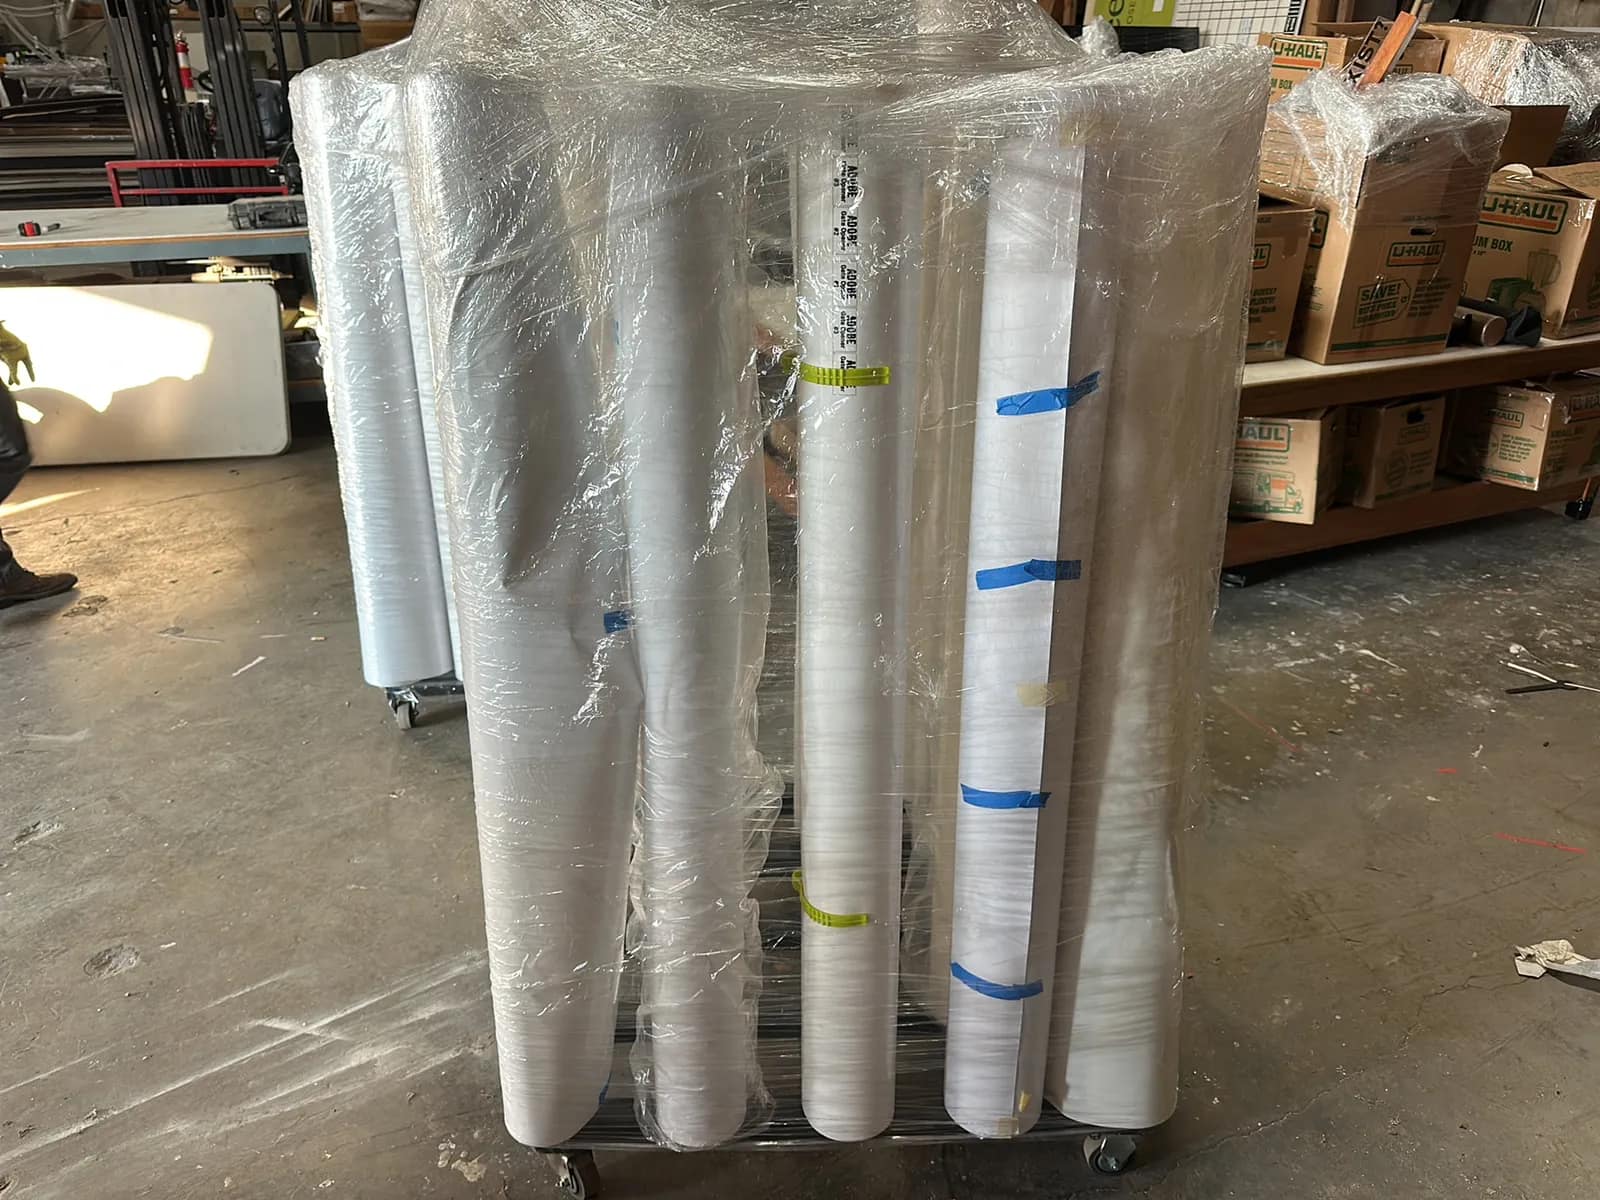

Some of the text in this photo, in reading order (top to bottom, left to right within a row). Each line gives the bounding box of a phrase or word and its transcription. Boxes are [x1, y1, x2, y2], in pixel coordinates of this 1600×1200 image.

[1273, 41, 1323, 60] U-HAUL
[847, 165, 858, 199] ADOBE
[1481, 196, 1559, 222] U-HAUL
[847, 215, 858, 247] ADOBE
[1391, 243, 1442, 257] U-HAUL
[1490, 239, 1514, 252] BOX
[847, 268, 858, 300] ADOBE
[847, 315, 858, 345] ADOBE
